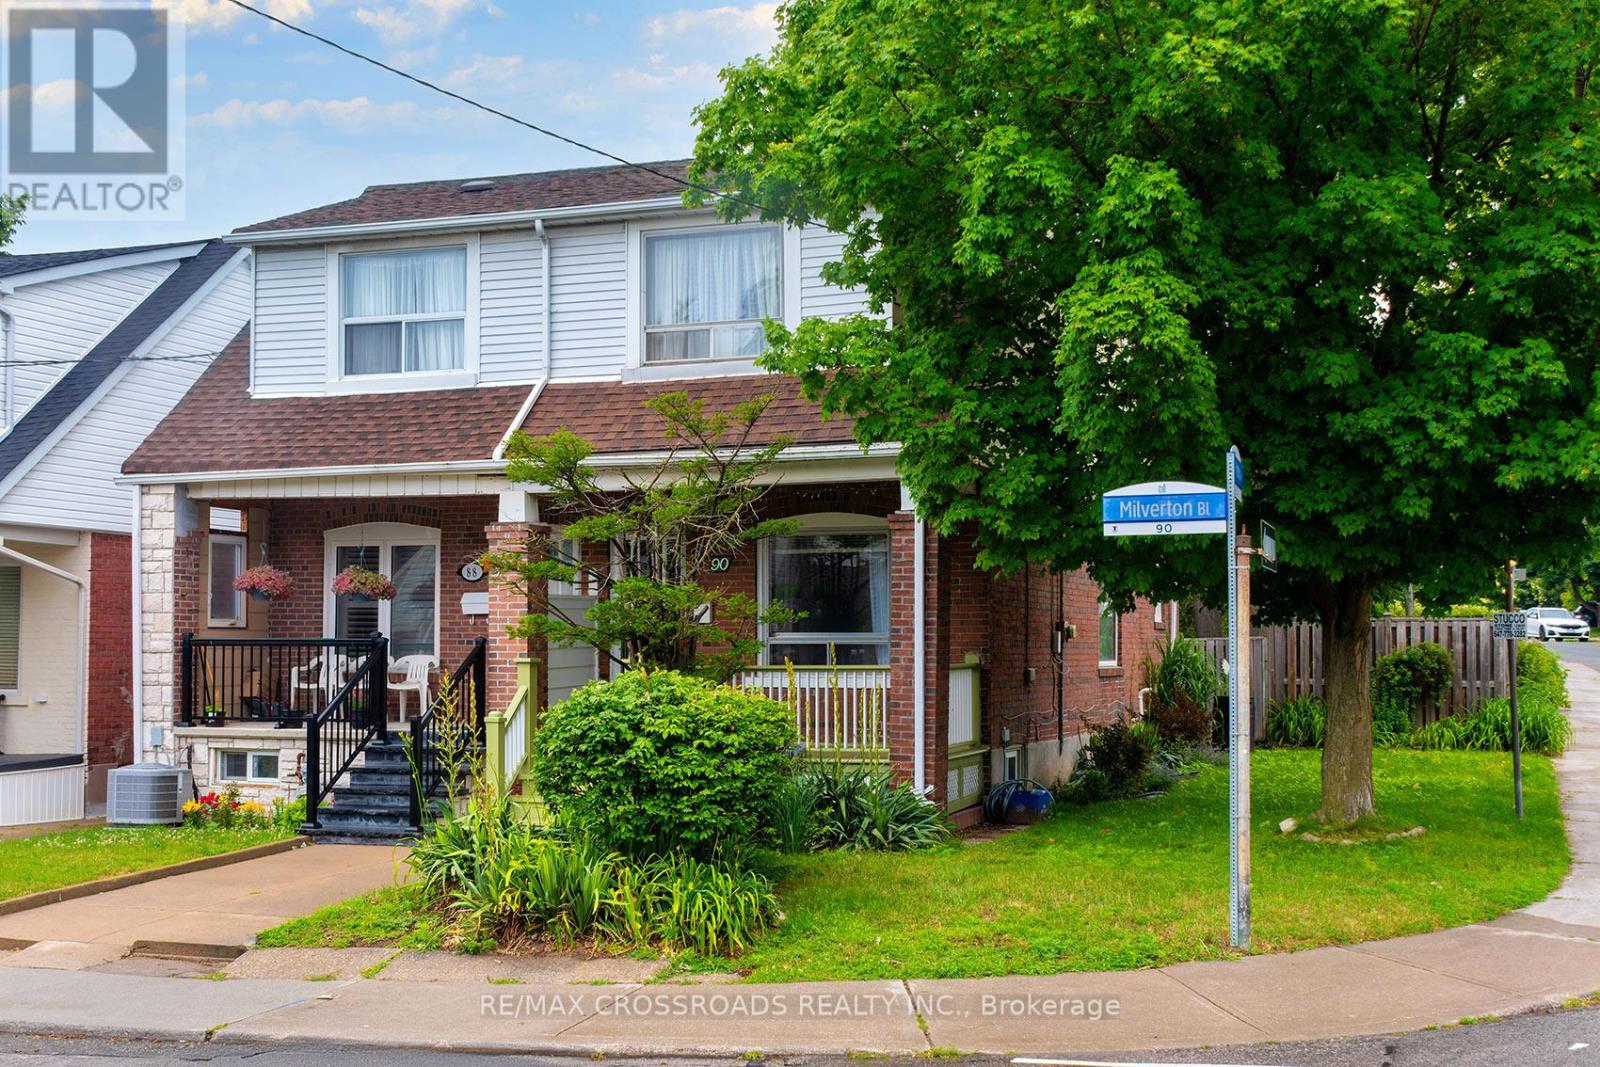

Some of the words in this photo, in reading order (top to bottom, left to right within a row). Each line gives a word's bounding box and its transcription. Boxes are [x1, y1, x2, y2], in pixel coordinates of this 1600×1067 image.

[1119, 499, 1193, 519] Milverton
[1197, 501, 1210, 516] Bl
[1155, 523, 1173, 534] 90
[710, 557, 729, 571] 90
[466, 566, 477, 578] 88
[1493, 613, 1525, 624] STUCCO
